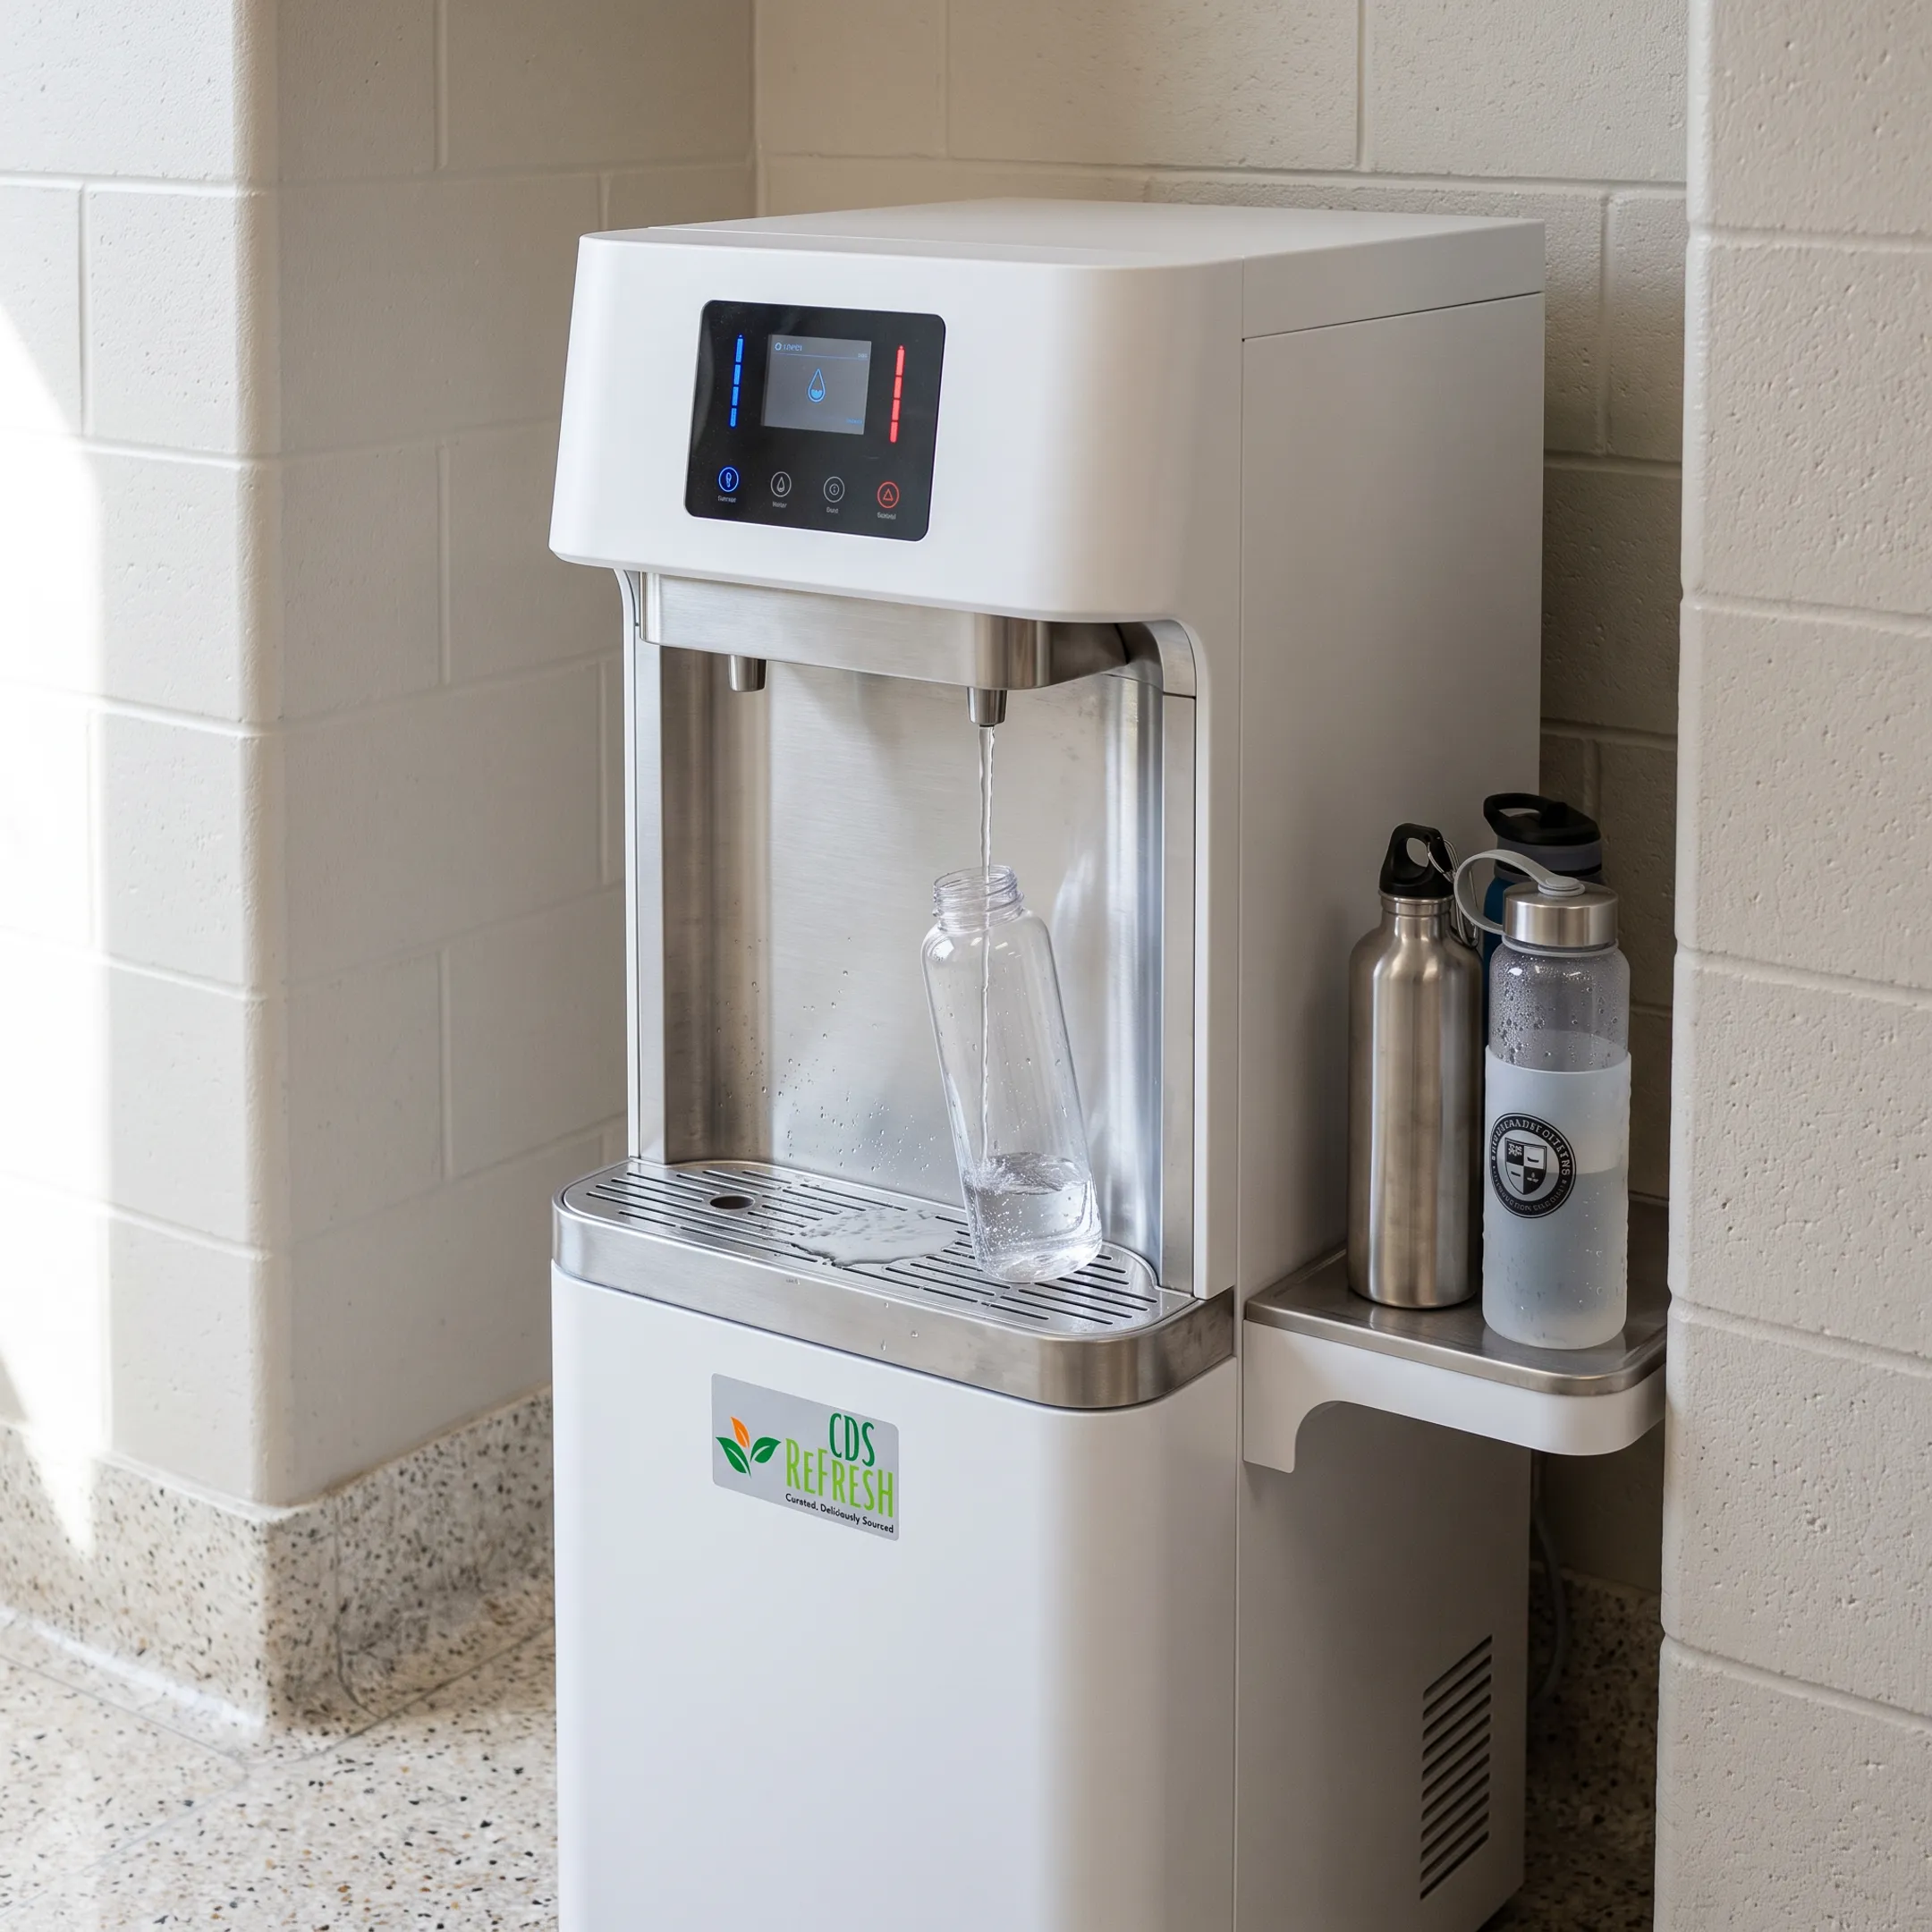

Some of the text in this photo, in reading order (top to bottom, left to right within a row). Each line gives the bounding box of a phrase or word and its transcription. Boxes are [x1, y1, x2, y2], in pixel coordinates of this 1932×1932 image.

[829, 1412, 876, 1467] CDS
[785, 1437, 894, 1518] REFRESH
[862, 1516, 894, 1533] Sourced
